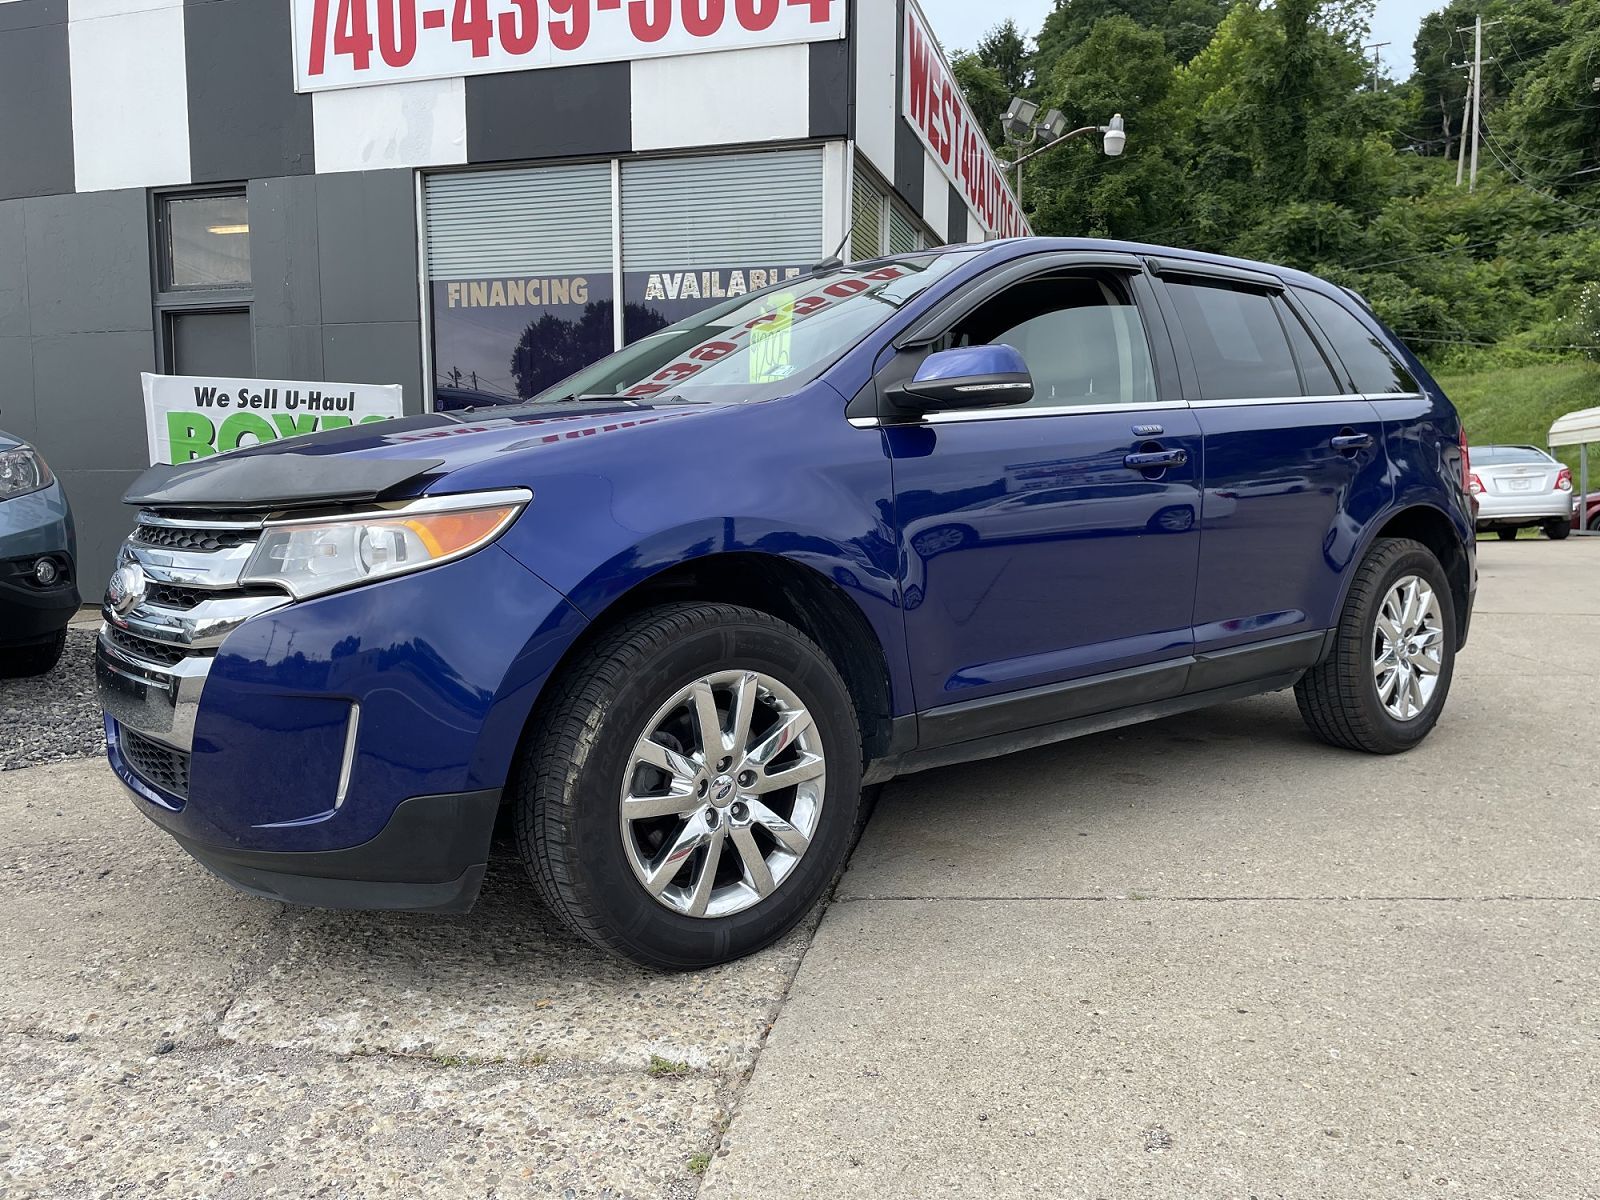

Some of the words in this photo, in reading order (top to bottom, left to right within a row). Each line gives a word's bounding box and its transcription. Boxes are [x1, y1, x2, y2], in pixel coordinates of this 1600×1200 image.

[308, 0, 837, 76] 740-439-
[908, 12, 961, 181] WEST
[961, 120, 977, 206] 40
[977, 148, 1006, 239] AUTO
[448, 277, 588, 308] FINANCING
[193, 386, 230, 408] We
[237, 388, 277, 410] Sell
[285, 391, 355, 411] U-Haul
